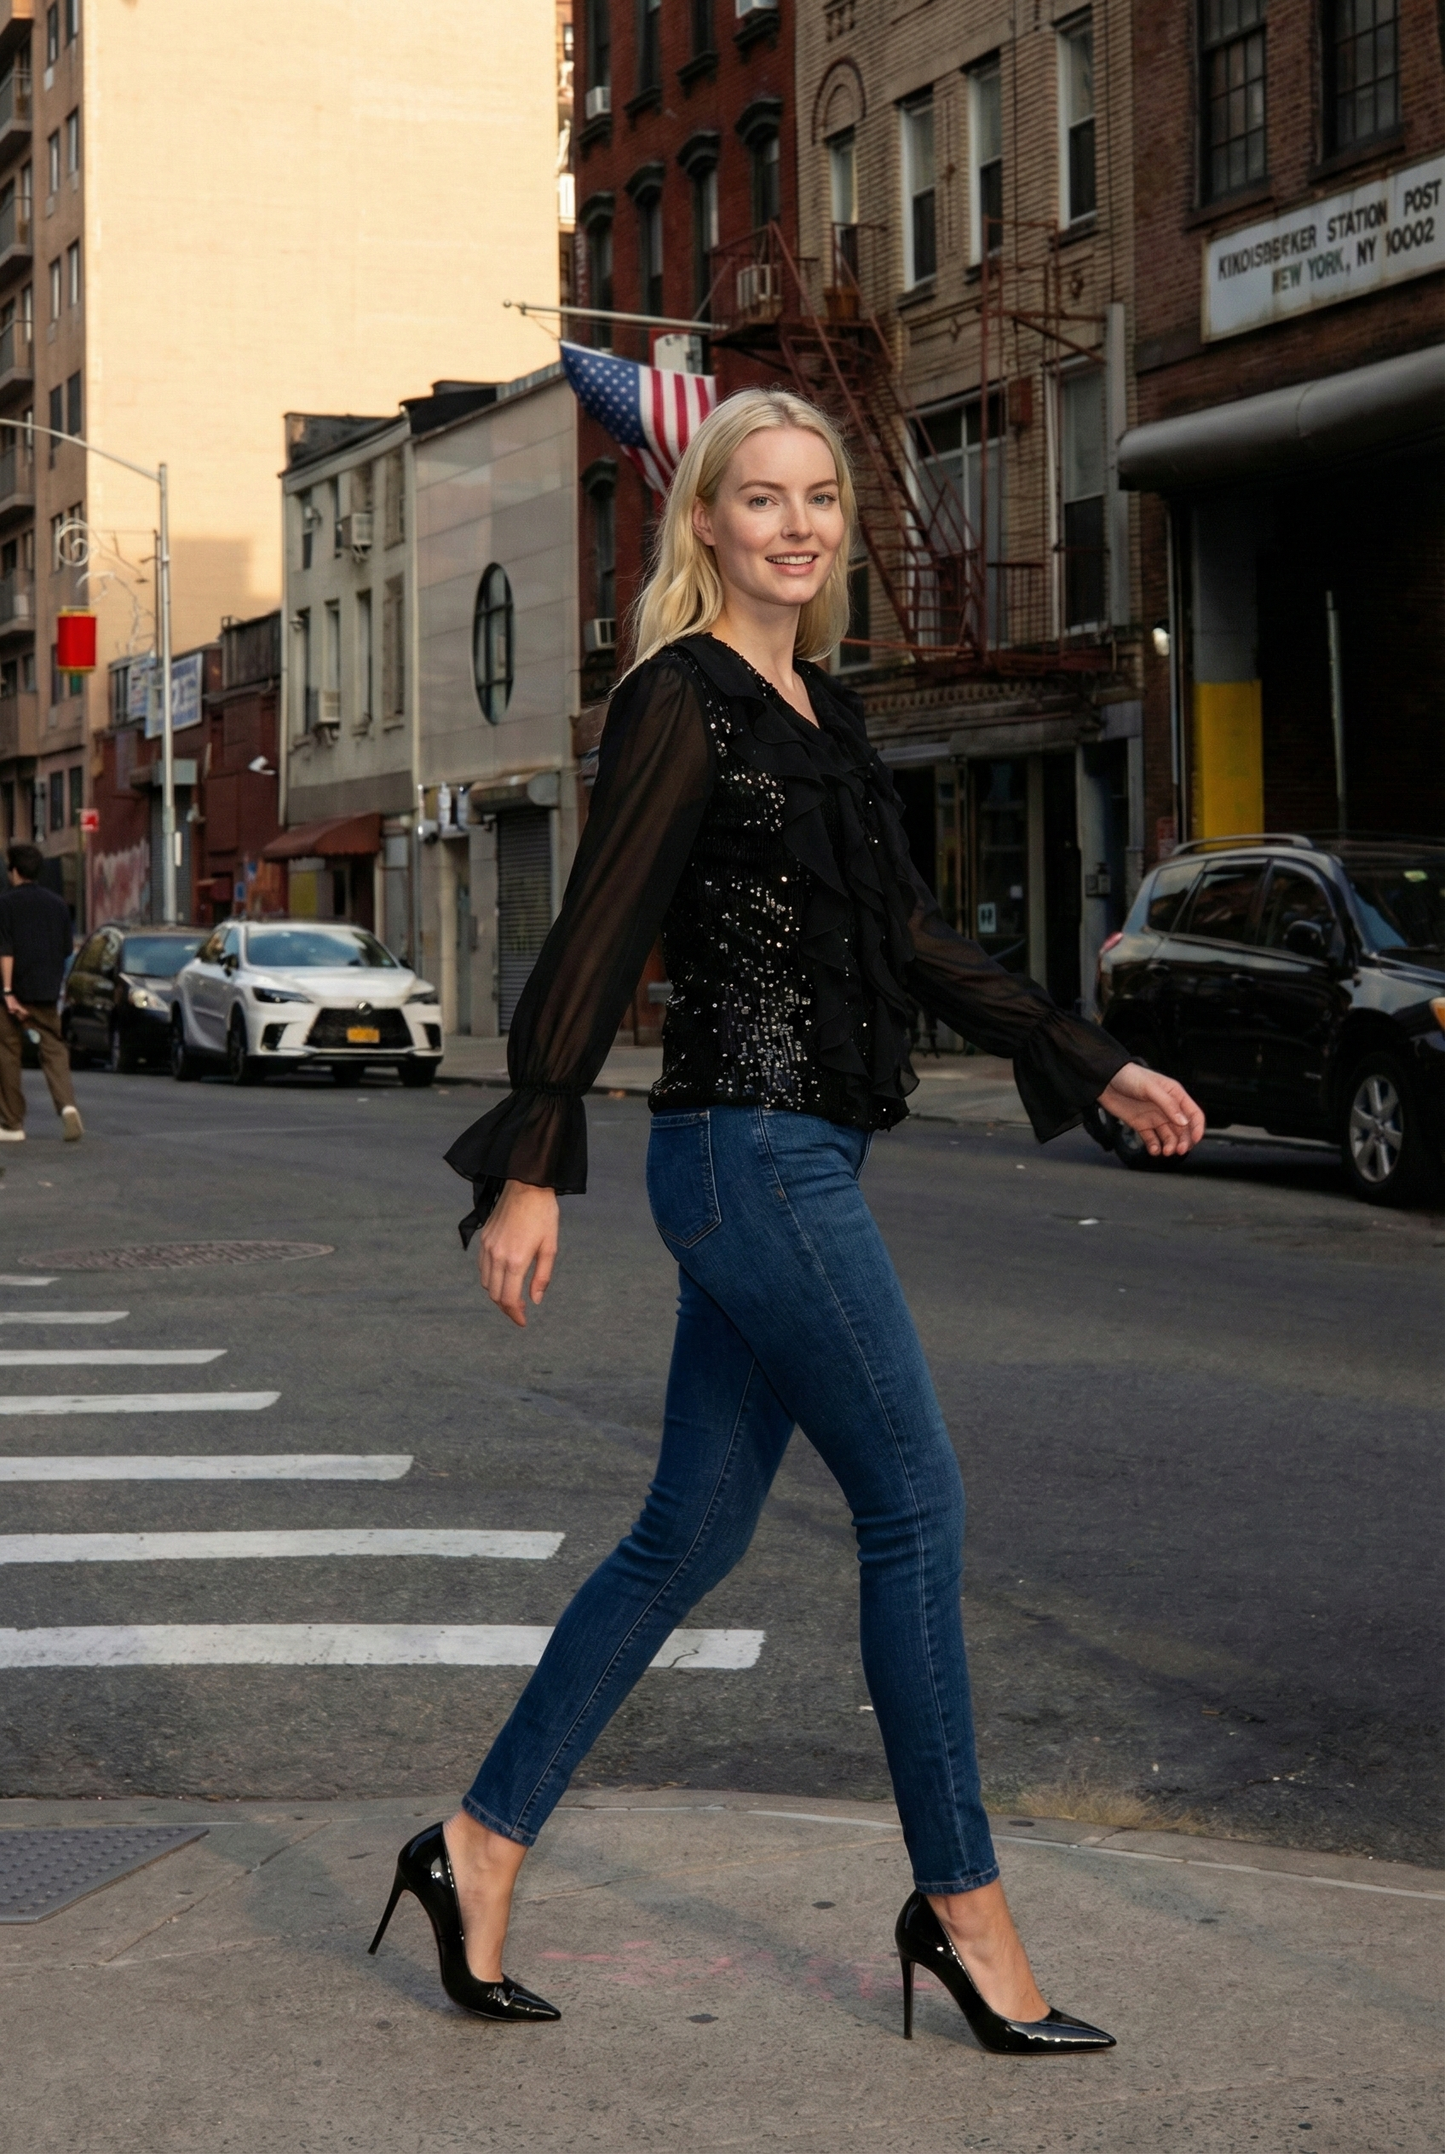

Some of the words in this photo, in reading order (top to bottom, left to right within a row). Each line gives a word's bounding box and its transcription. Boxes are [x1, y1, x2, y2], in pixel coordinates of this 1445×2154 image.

[1327, 200, 1388, 243] STATION
[1404, 179, 1442, 216] POST
[1357, 236, 1377, 267] NY
[1386, 217, 1435, 257] 10002
